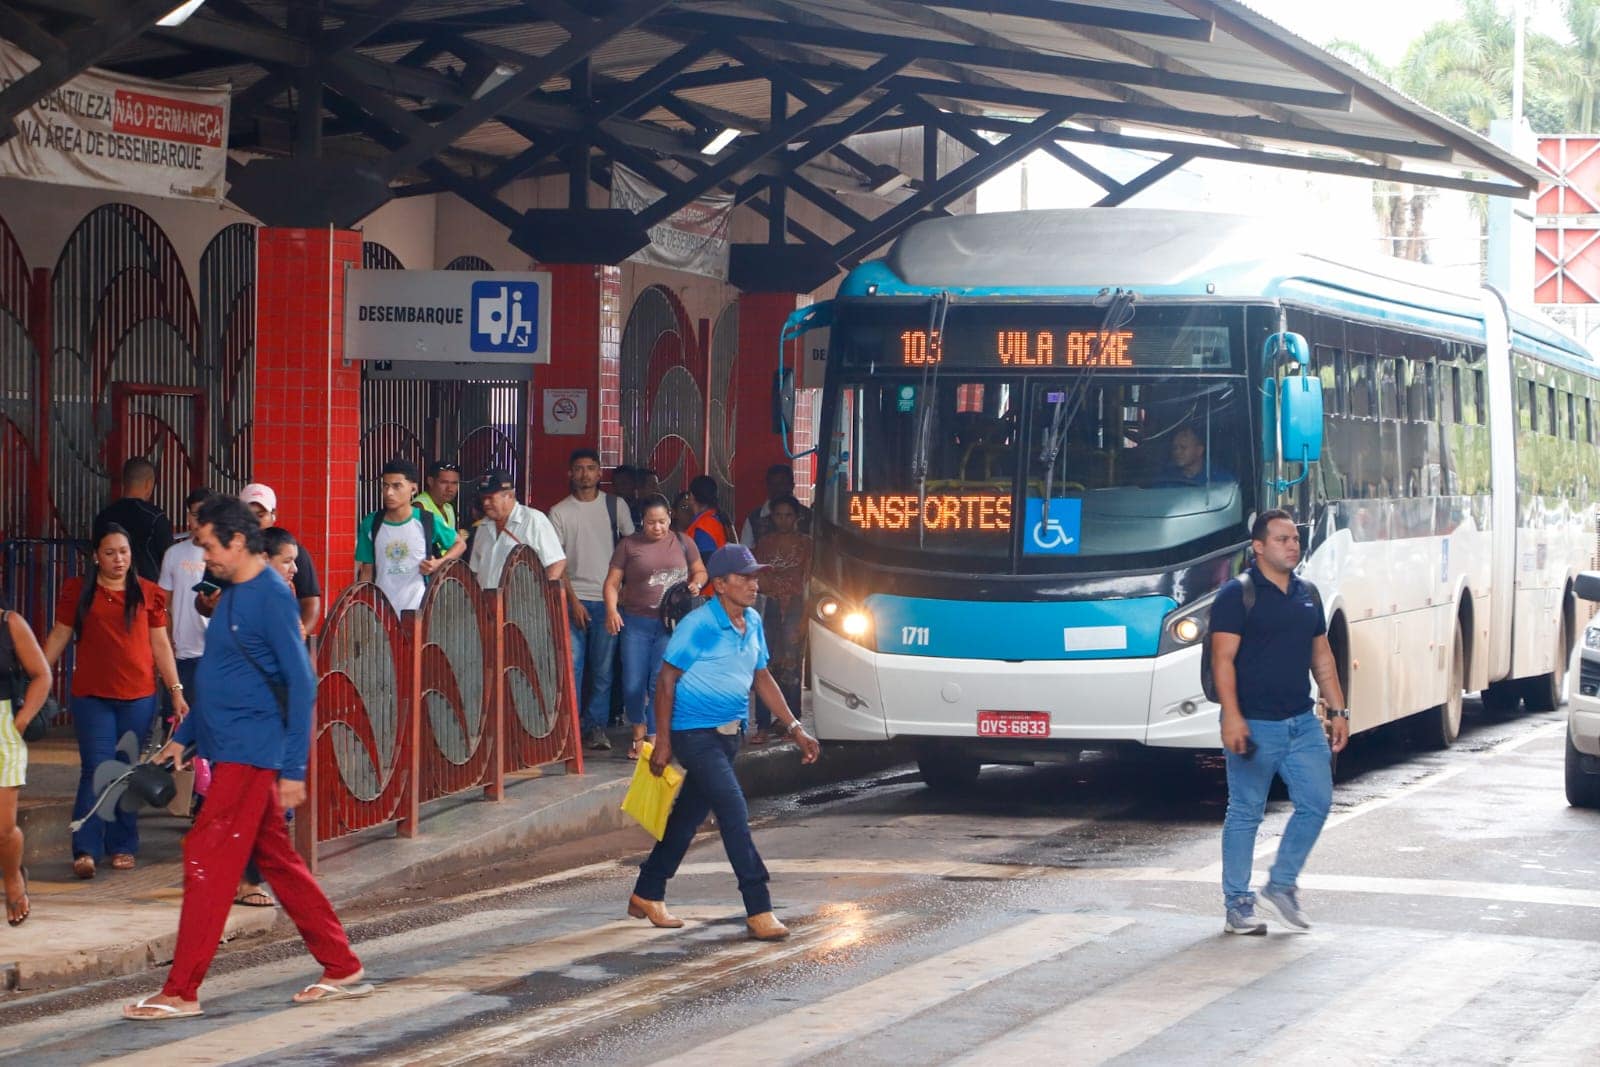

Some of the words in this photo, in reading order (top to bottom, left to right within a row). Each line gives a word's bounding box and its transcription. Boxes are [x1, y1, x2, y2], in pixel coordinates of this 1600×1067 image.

[115, 94, 144, 127] NÃO
[146, 104, 222, 143] PERMANEÇA
[21, 119, 41, 148] NA
[45, 117, 83, 154] ÁREA
[86, 131, 104, 156] DE
[107, 135, 205, 171] DESEMBARQUE.
[359, 304, 464, 324] DESEMBARQUE
[998, 330, 1053, 365] VILA
[1067, 331, 1134, 366] ACRE
[850, 495, 1012, 530] ANSPORTES
[902, 626, 929, 647] 1711
